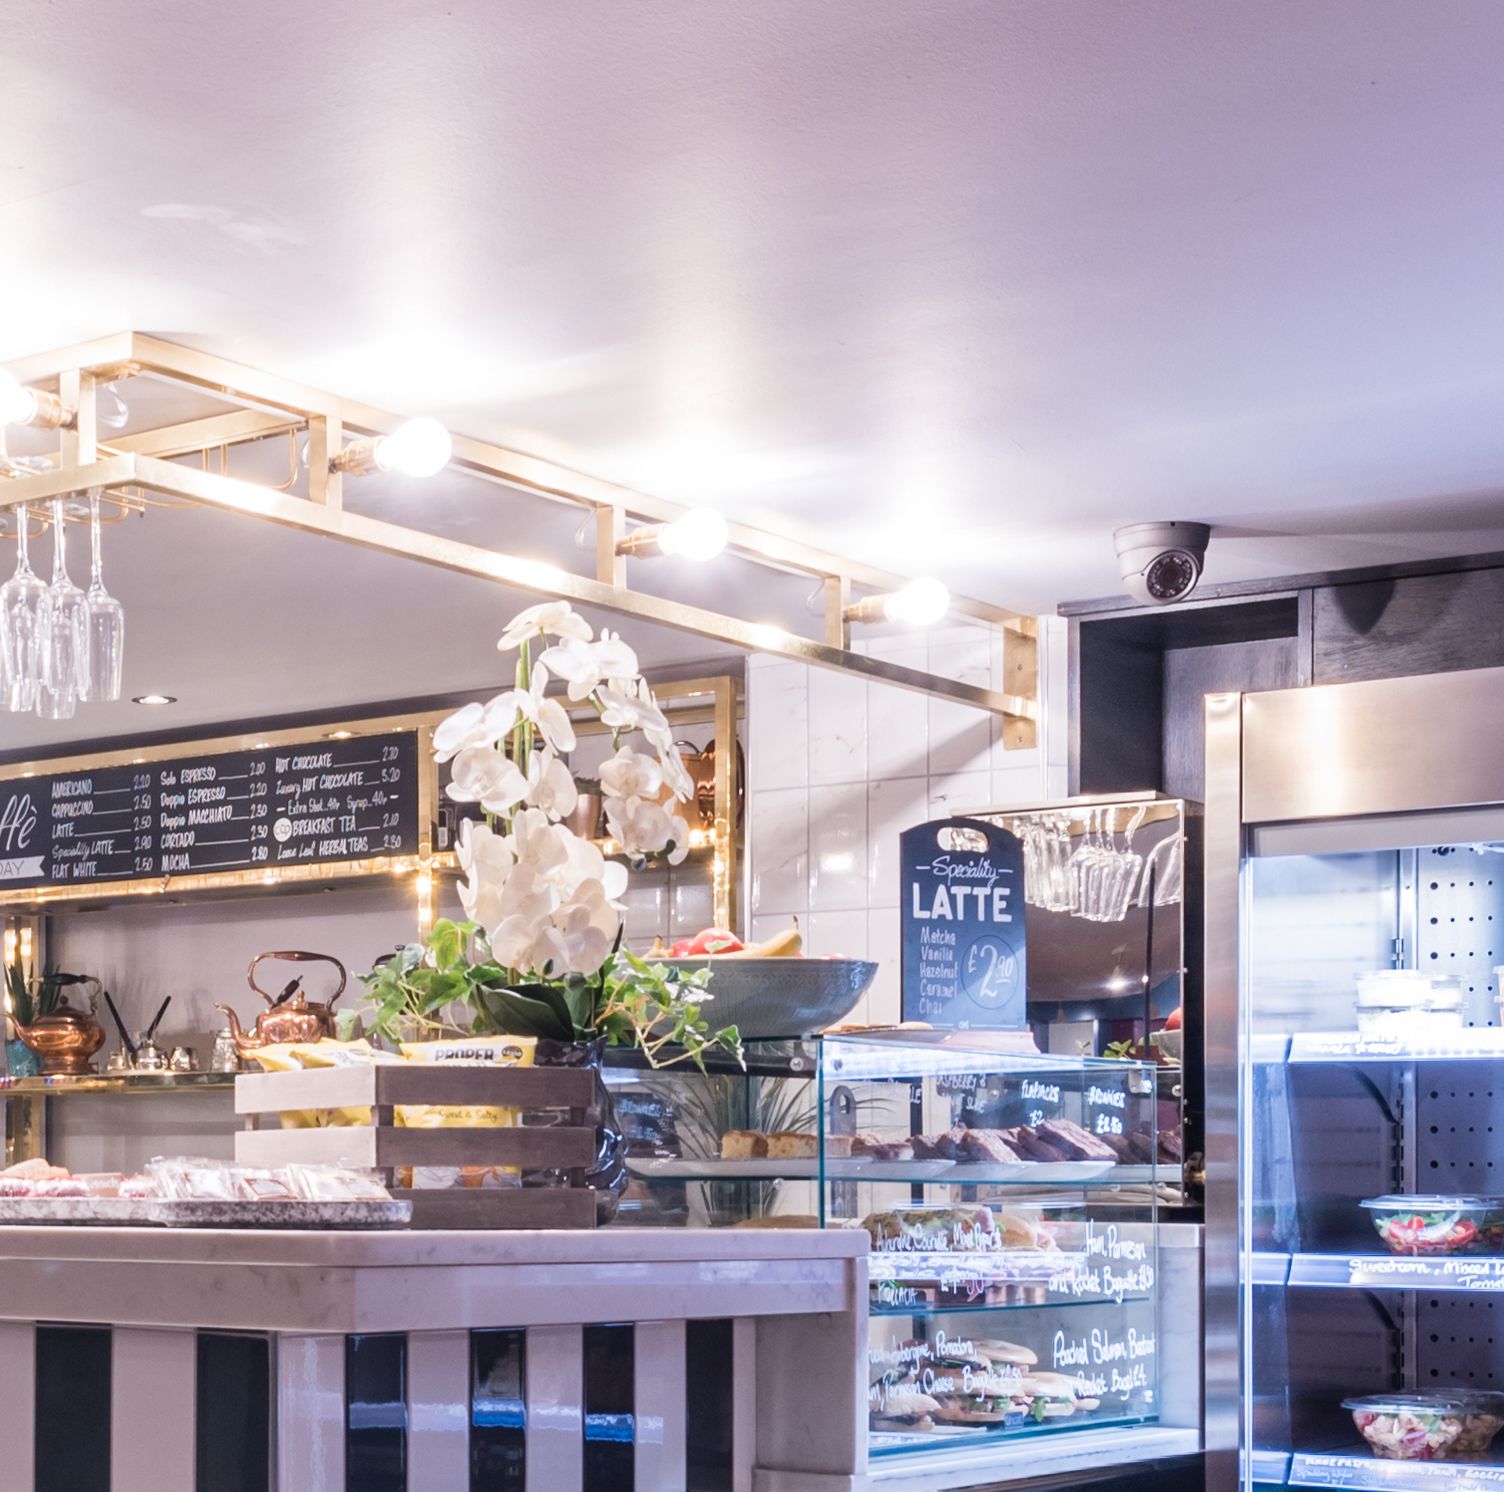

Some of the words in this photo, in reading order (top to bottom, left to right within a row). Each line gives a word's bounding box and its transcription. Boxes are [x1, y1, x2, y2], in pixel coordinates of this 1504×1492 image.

[276, 757, 291, 773] HOT
[292, 753, 333, 770] CHOCOLATE
[181, 767, 216, 784] ESPRESSO
[250, 762, 266, 776] 2.00
[302, 776, 318, 792] HOT
[319, 771, 363, 790] CHOCOLATE
[51, 779, 92, 799] AMERICANO
[160, 792, 185, 809] Doppio
[188, 787, 226, 804] ESPRESSO
[51, 800, 94, 819] CAPPUCCINO
[160, 813, 185, 829] Doppio
[188, 806, 232, 825] MACCHIATO
[52, 822, 75, 839] LATTE
[292, 818, 335, 837] BREAKFAST
[340, 815, 356, 833] TEA
[90, 839, 115, 855] LATTE
[160, 831, 195, 850] CORTADO
[319, 840, 347, 857] HERBAL
[347, 837, 368, 853] TEAS
[52, 864, 68, 879] FLAT
[73, 861, 98, 877] WHITE
[161, 853, 190, 872] MOCHA
[932, 855, 999, 888] Speciality
[912, 882, 1012, 922] LATTE
[921, 927, 956, 945] Matcha
[921, 947, 953, 961] Vanilla
[920, 962, 958, 979] Hazelnut
[920, 979, 957, 998] Caramel
[919, 998, 942, 1014] Chai
[1444, 1261, 1489, 1275] Mixed
